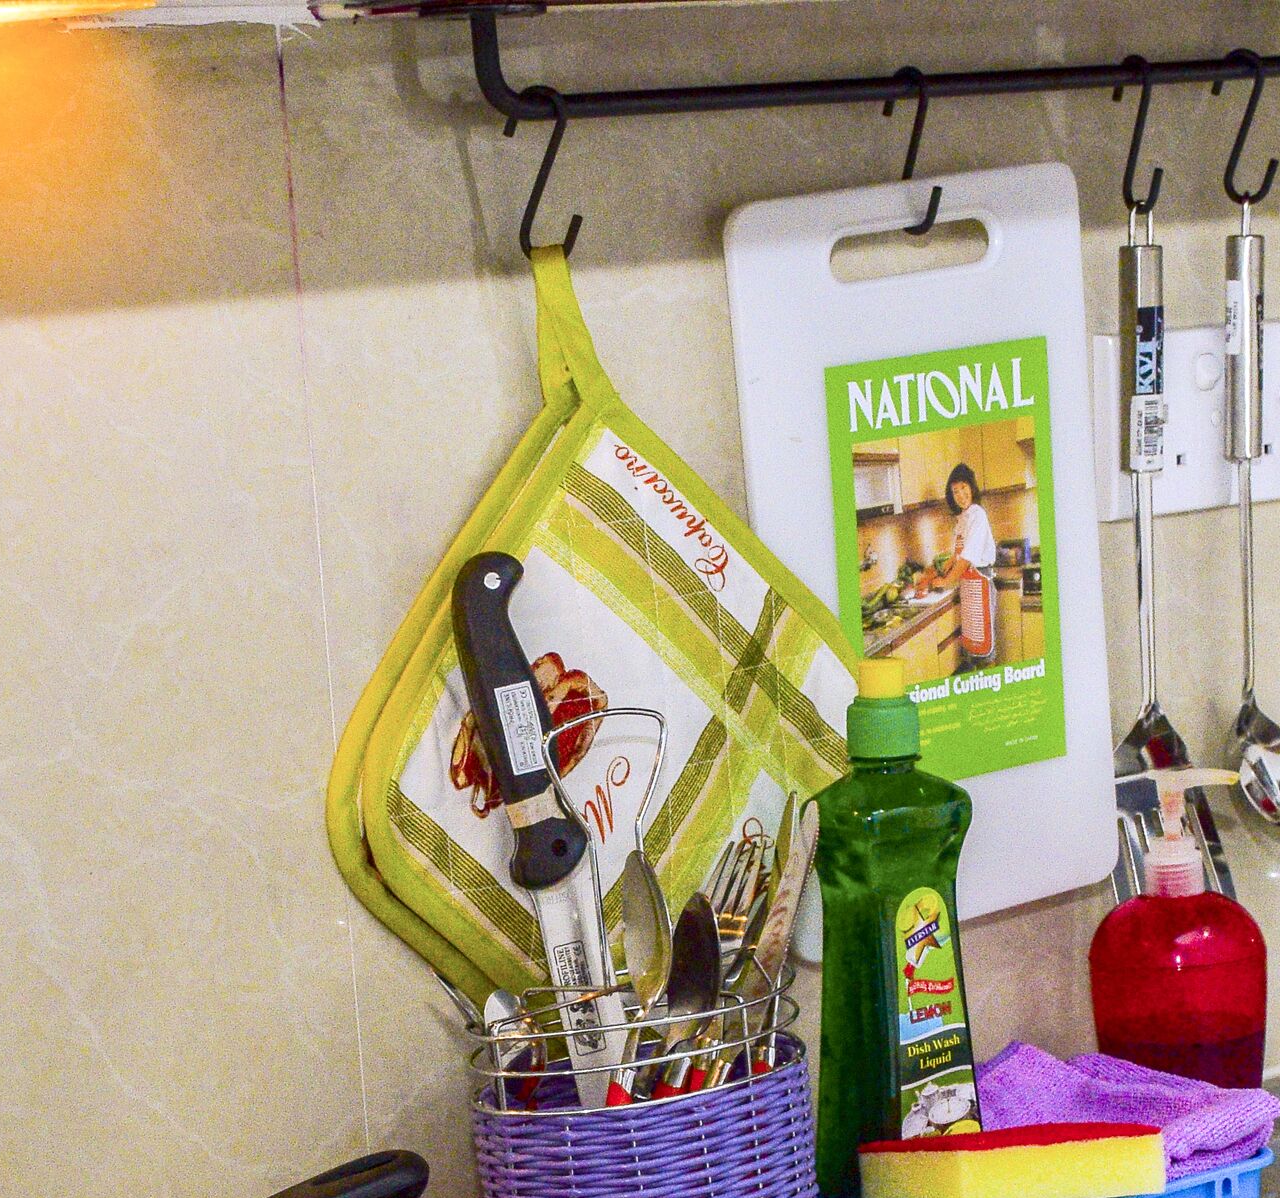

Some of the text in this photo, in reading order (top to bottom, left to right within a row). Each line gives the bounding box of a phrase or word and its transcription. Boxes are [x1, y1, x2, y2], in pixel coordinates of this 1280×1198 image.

[847, 358, 1035, 432] NATIONAL
[614, 444, 729, 592] Cappuccino
[905, 658, 1045, 703] sional Cutting Board
[907, 921, 938, 947] EVERSTAR
[557, 949, 572, 987] ROFILINE
[910, 1001, 952, 1024] LEMON
[907, 1034, 961, 1058] Dish Wash
[920, 1051, 952, 1070] Liquid
